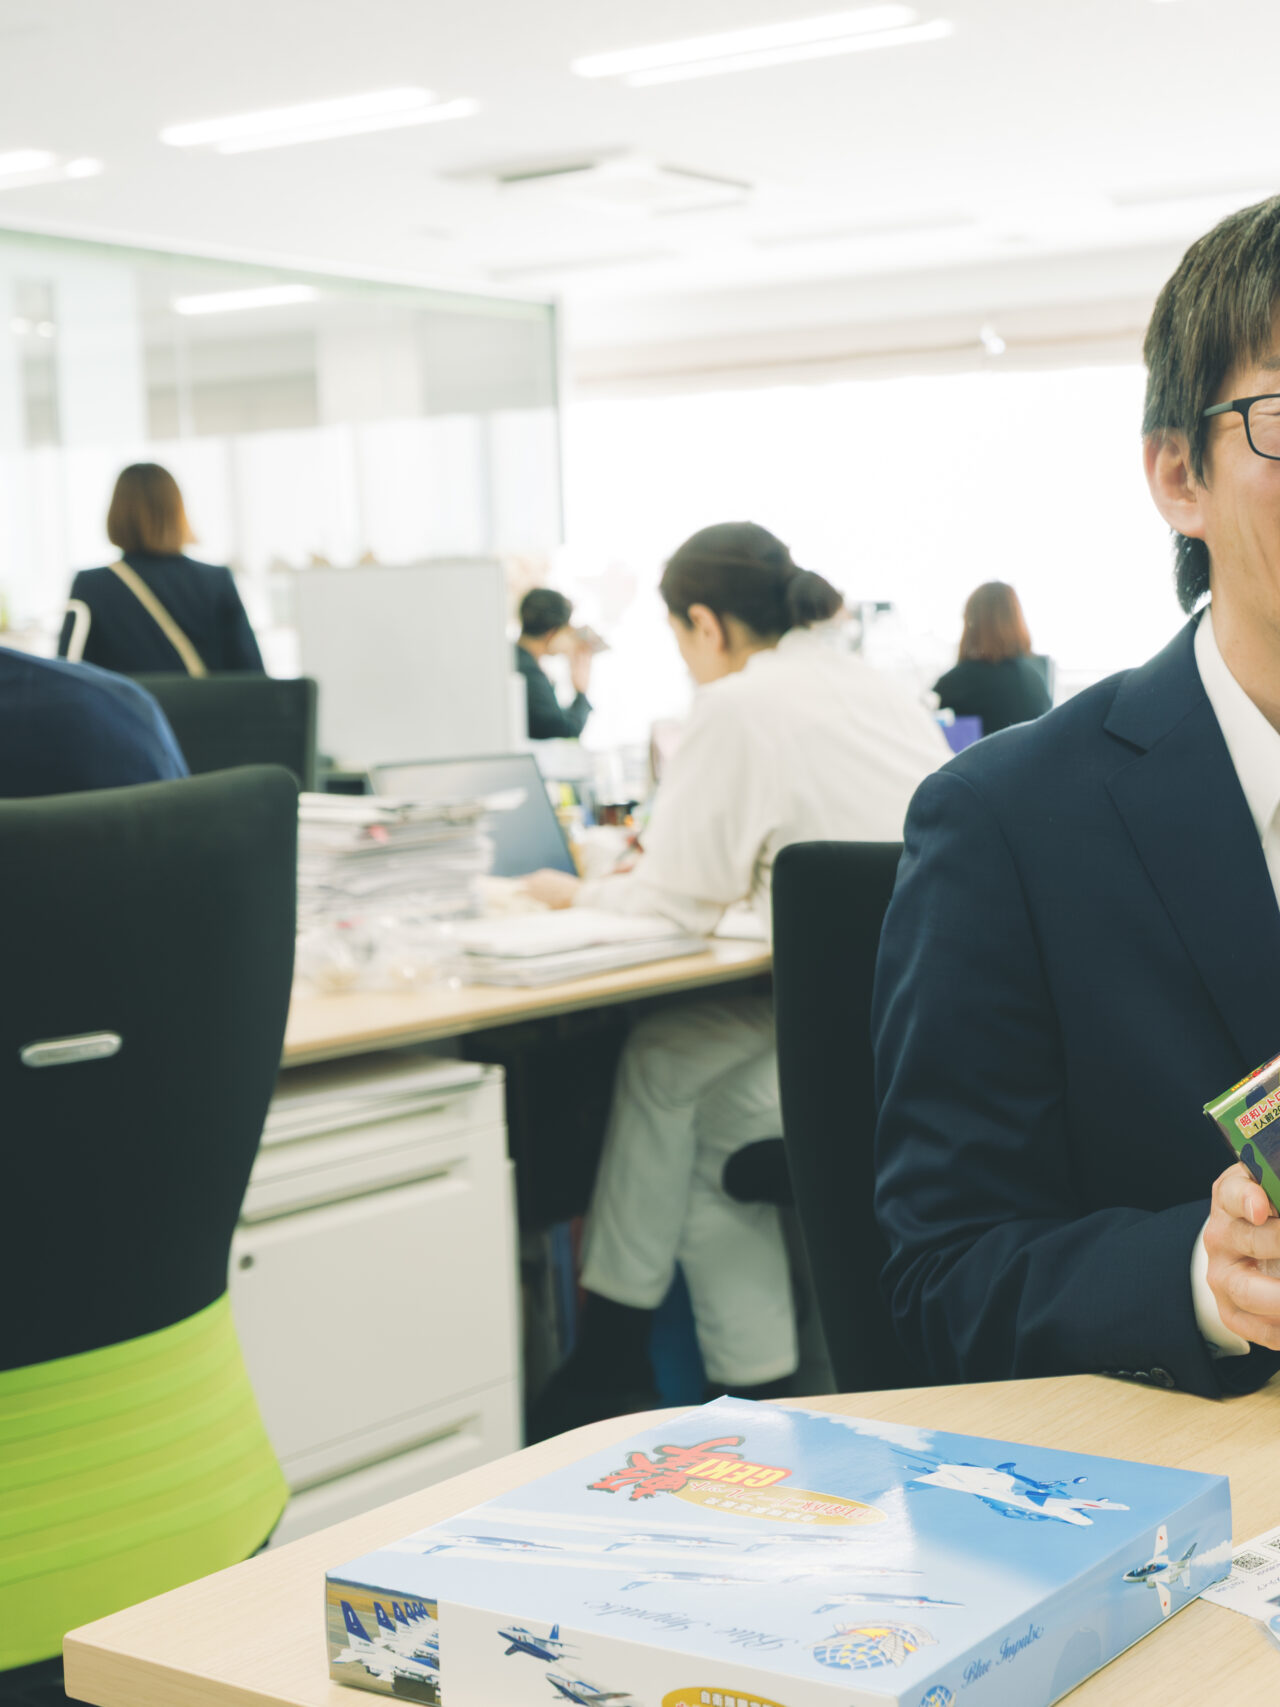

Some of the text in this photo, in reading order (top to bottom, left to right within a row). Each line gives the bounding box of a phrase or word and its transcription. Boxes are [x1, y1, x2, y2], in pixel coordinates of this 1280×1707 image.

[684, 1458, 788, 1488] GEKI
[961, 1624, 1045, 1689] Blue Impulse
